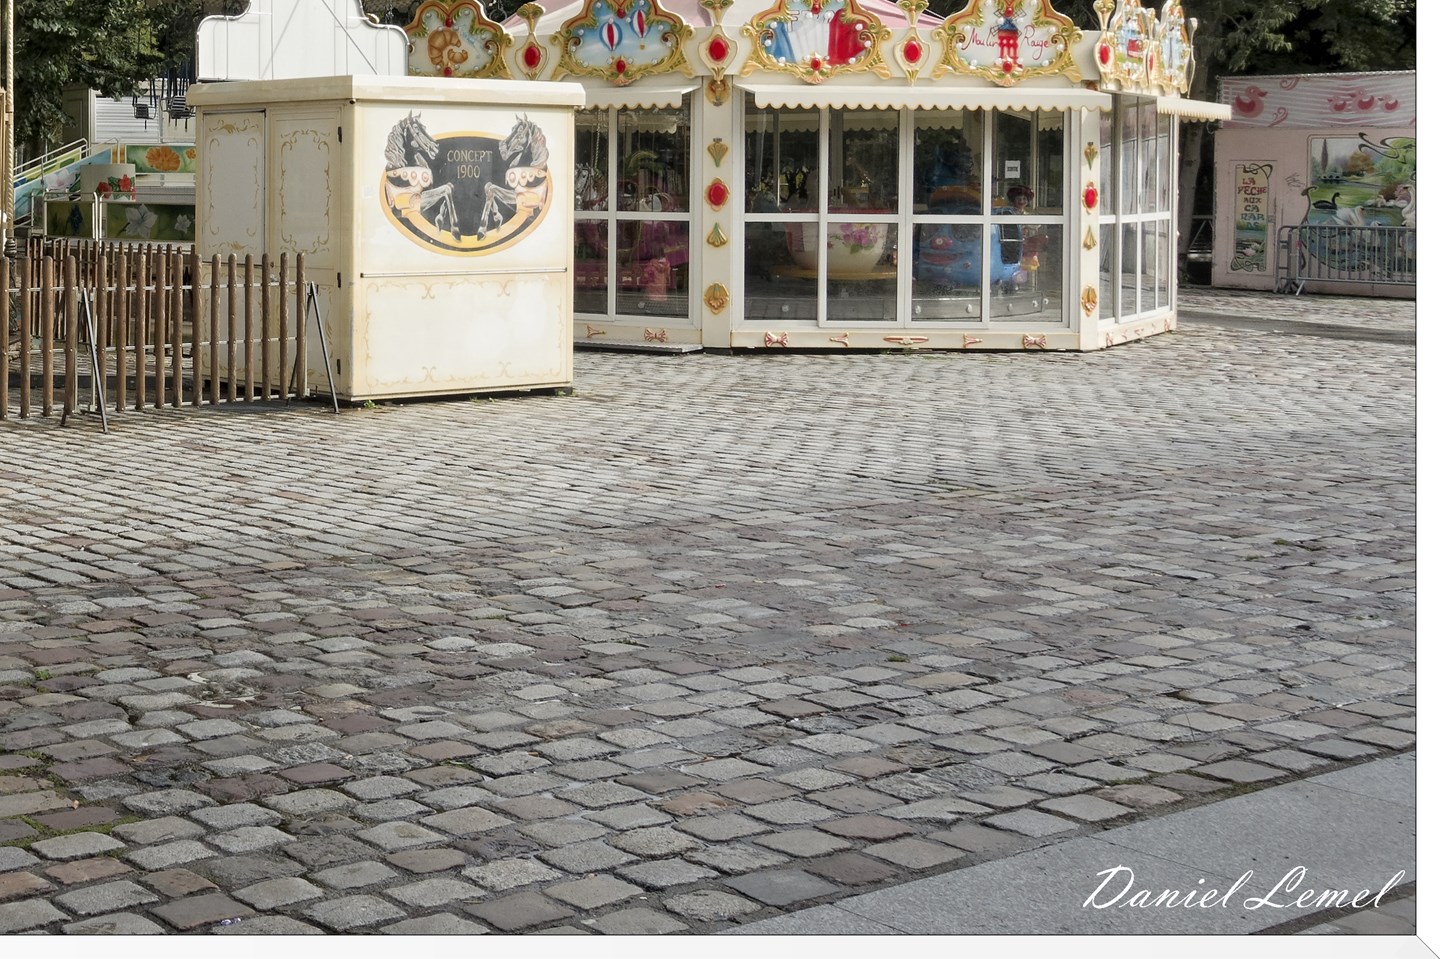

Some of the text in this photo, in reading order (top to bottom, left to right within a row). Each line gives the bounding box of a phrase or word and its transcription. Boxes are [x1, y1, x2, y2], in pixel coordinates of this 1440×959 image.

[1021, 24, 1049, 60] Rouge
[446, 149, 493, 162] CONCEPT
[456, 165, 481, 178] 1900
[1242, 177, 1256, 185] LA
[1244, 204, 1260, 213] CA
